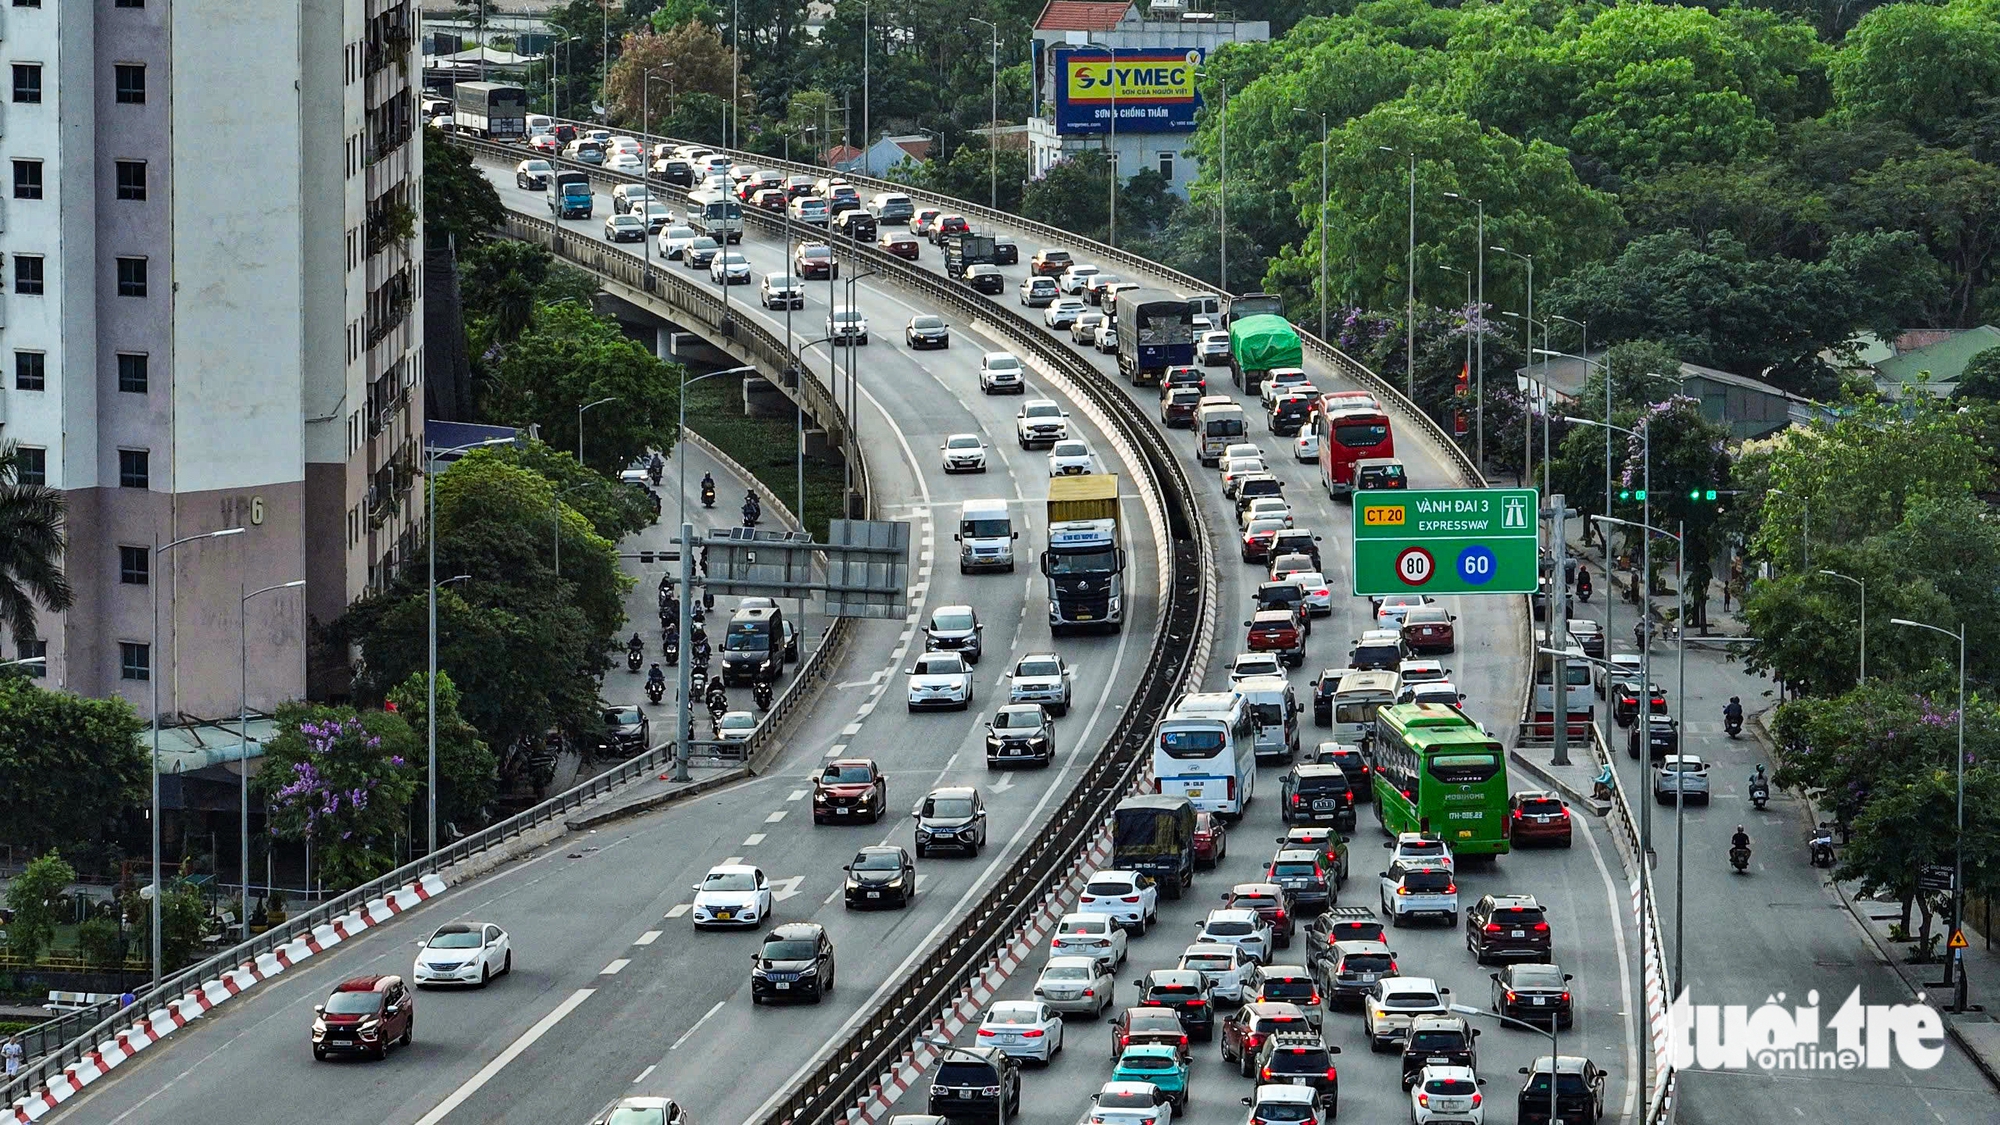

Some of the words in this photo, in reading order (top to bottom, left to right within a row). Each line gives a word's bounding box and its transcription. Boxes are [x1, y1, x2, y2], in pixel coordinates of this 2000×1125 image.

[1099, 68, 1186, 87] JYMEC
[1120, 106, 1146, 118] CHỐNG
[1148, 106, 1169, 118] THẤM
[1416, 498, 1451, 513] VÀNH
[1455, 500, 1477, 513] ĐAI
[1481, 500, 1489, 512] 3
[1367, 509, 1402, 522] CT.20
[1418, 519, 1489, 531] EXPRESSWAY
[1406, 557, 1424, 575] 80
[1465, 556, 1489, 574] 60
